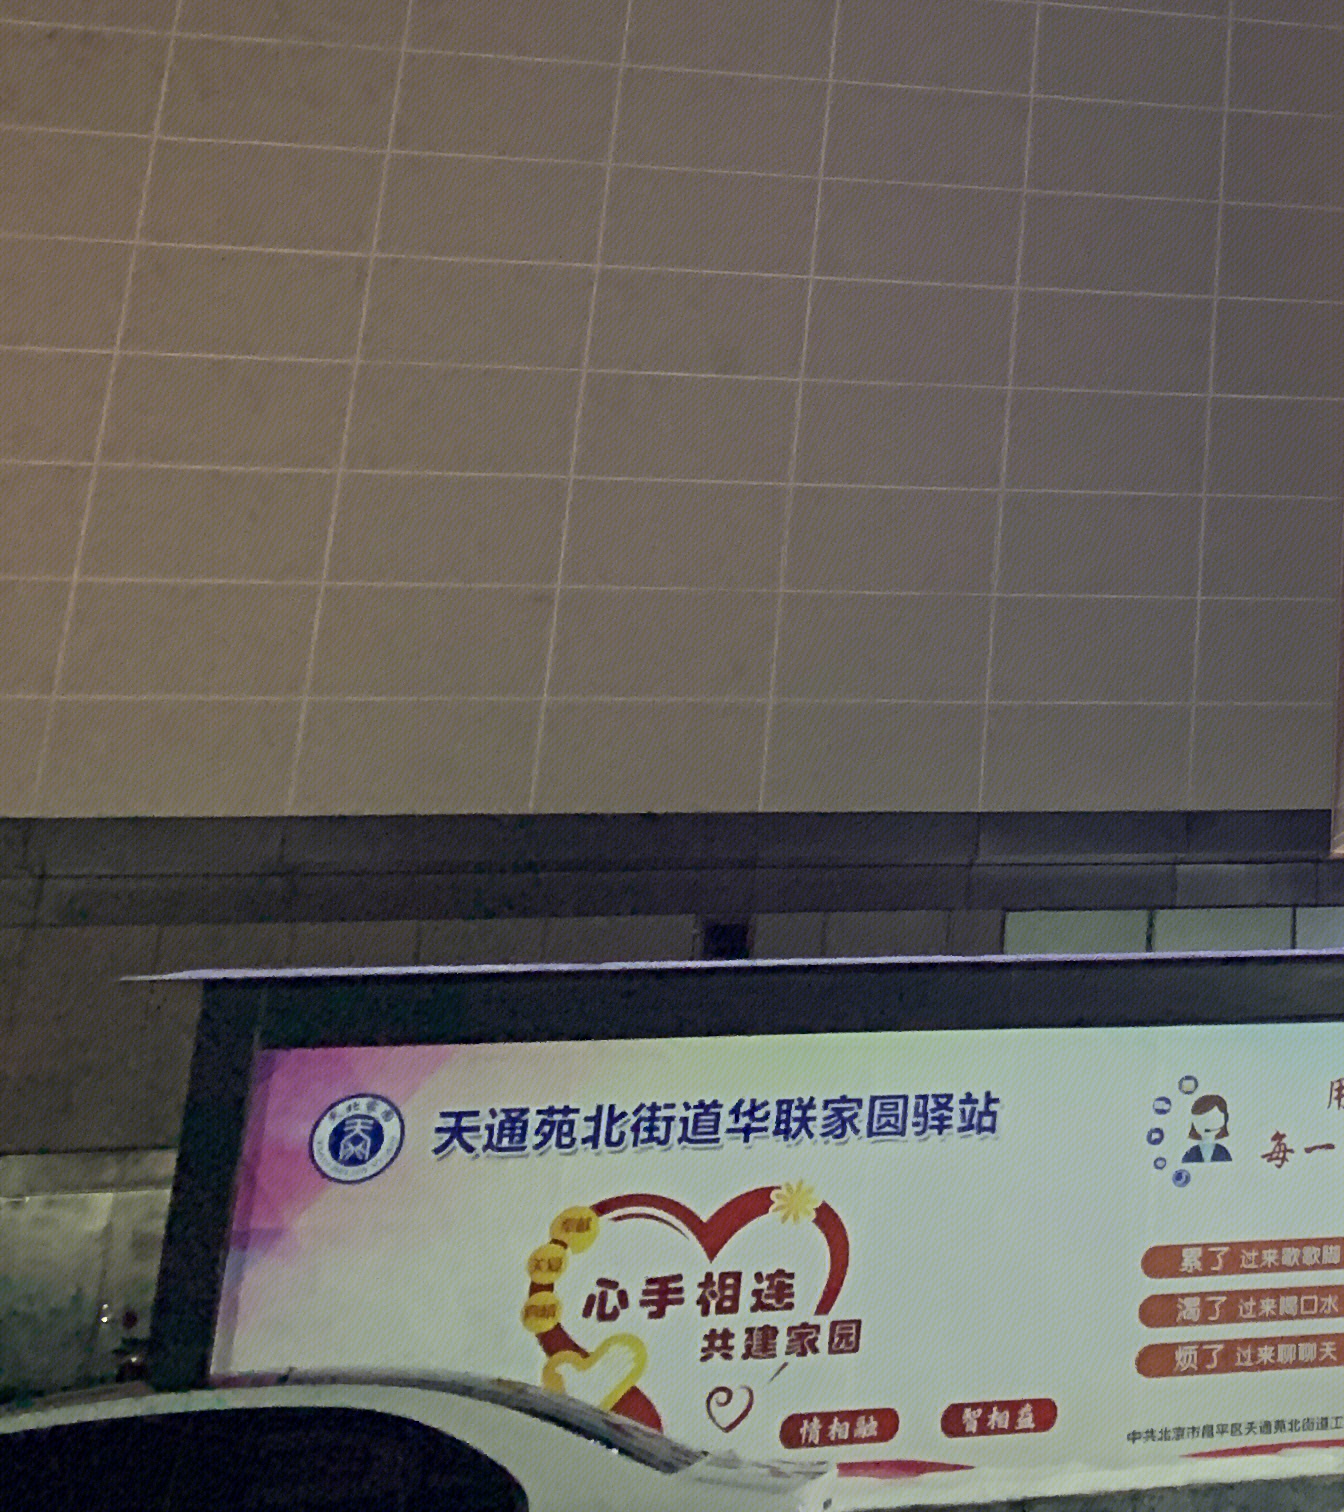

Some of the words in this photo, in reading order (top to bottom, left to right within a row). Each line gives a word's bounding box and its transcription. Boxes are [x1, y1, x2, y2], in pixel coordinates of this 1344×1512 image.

[431, 1090, 1001, 1157] 天通苑北街道华联家圆驿站
[1180, 1246, 1230, 1274] 累了
[581, 1268, 796, 1323] 心手相连
[1176, 1295, 1228, 1323] 渴了
[1237, 1293, 1340, 1319] 过来喝口水
[699, 1318, 862, 1363] 共建家园
[1172, 1343, 1225, 1372] 烦了
[1234, 1341, 1338, 1367] 过来聊聊天
